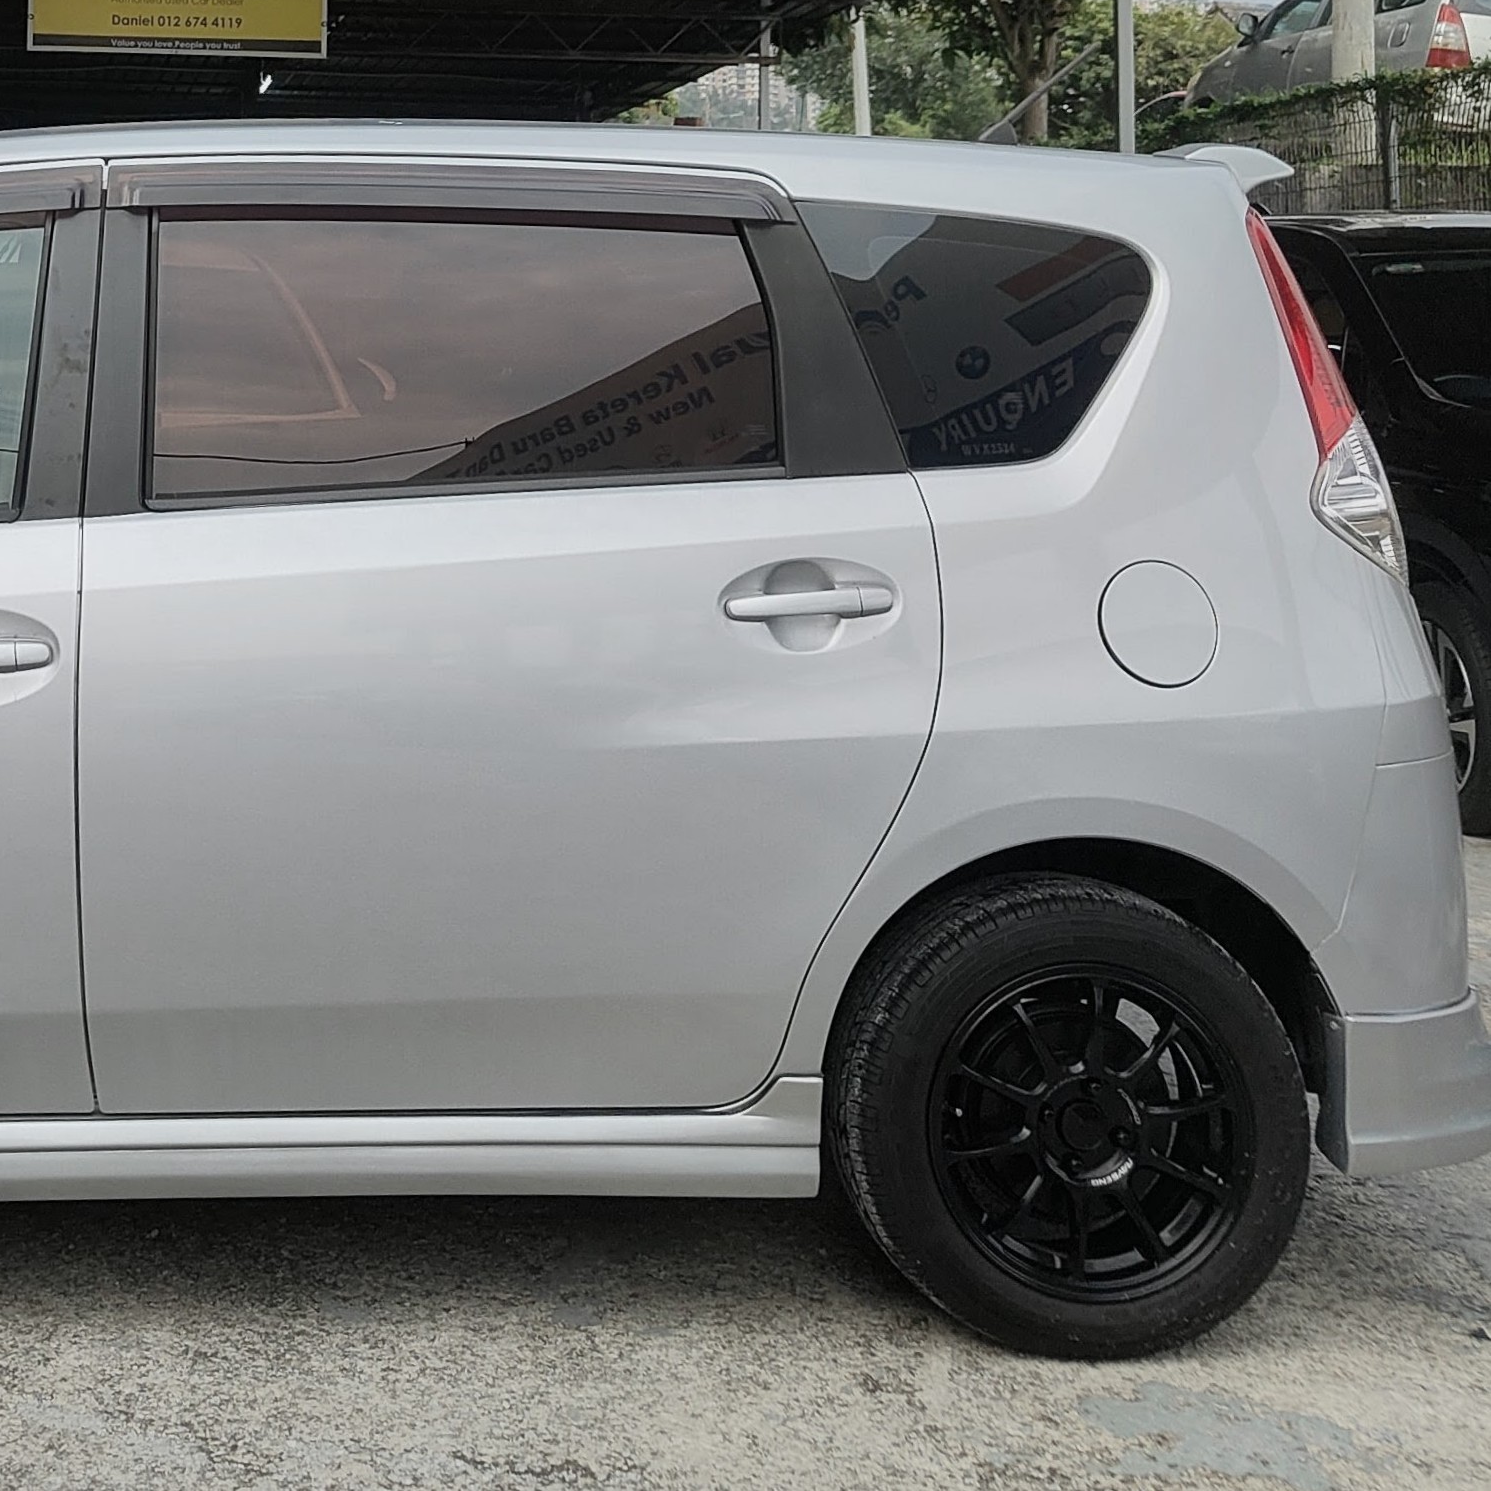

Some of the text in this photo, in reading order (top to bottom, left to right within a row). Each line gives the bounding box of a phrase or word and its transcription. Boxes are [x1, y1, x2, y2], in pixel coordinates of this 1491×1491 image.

[112, 13, 243, 29] Daniel 012 674 4119
[110, 39, 136, 49] Value
[136, 41, 153, 51] you
[205, 42, 222, 52] you
